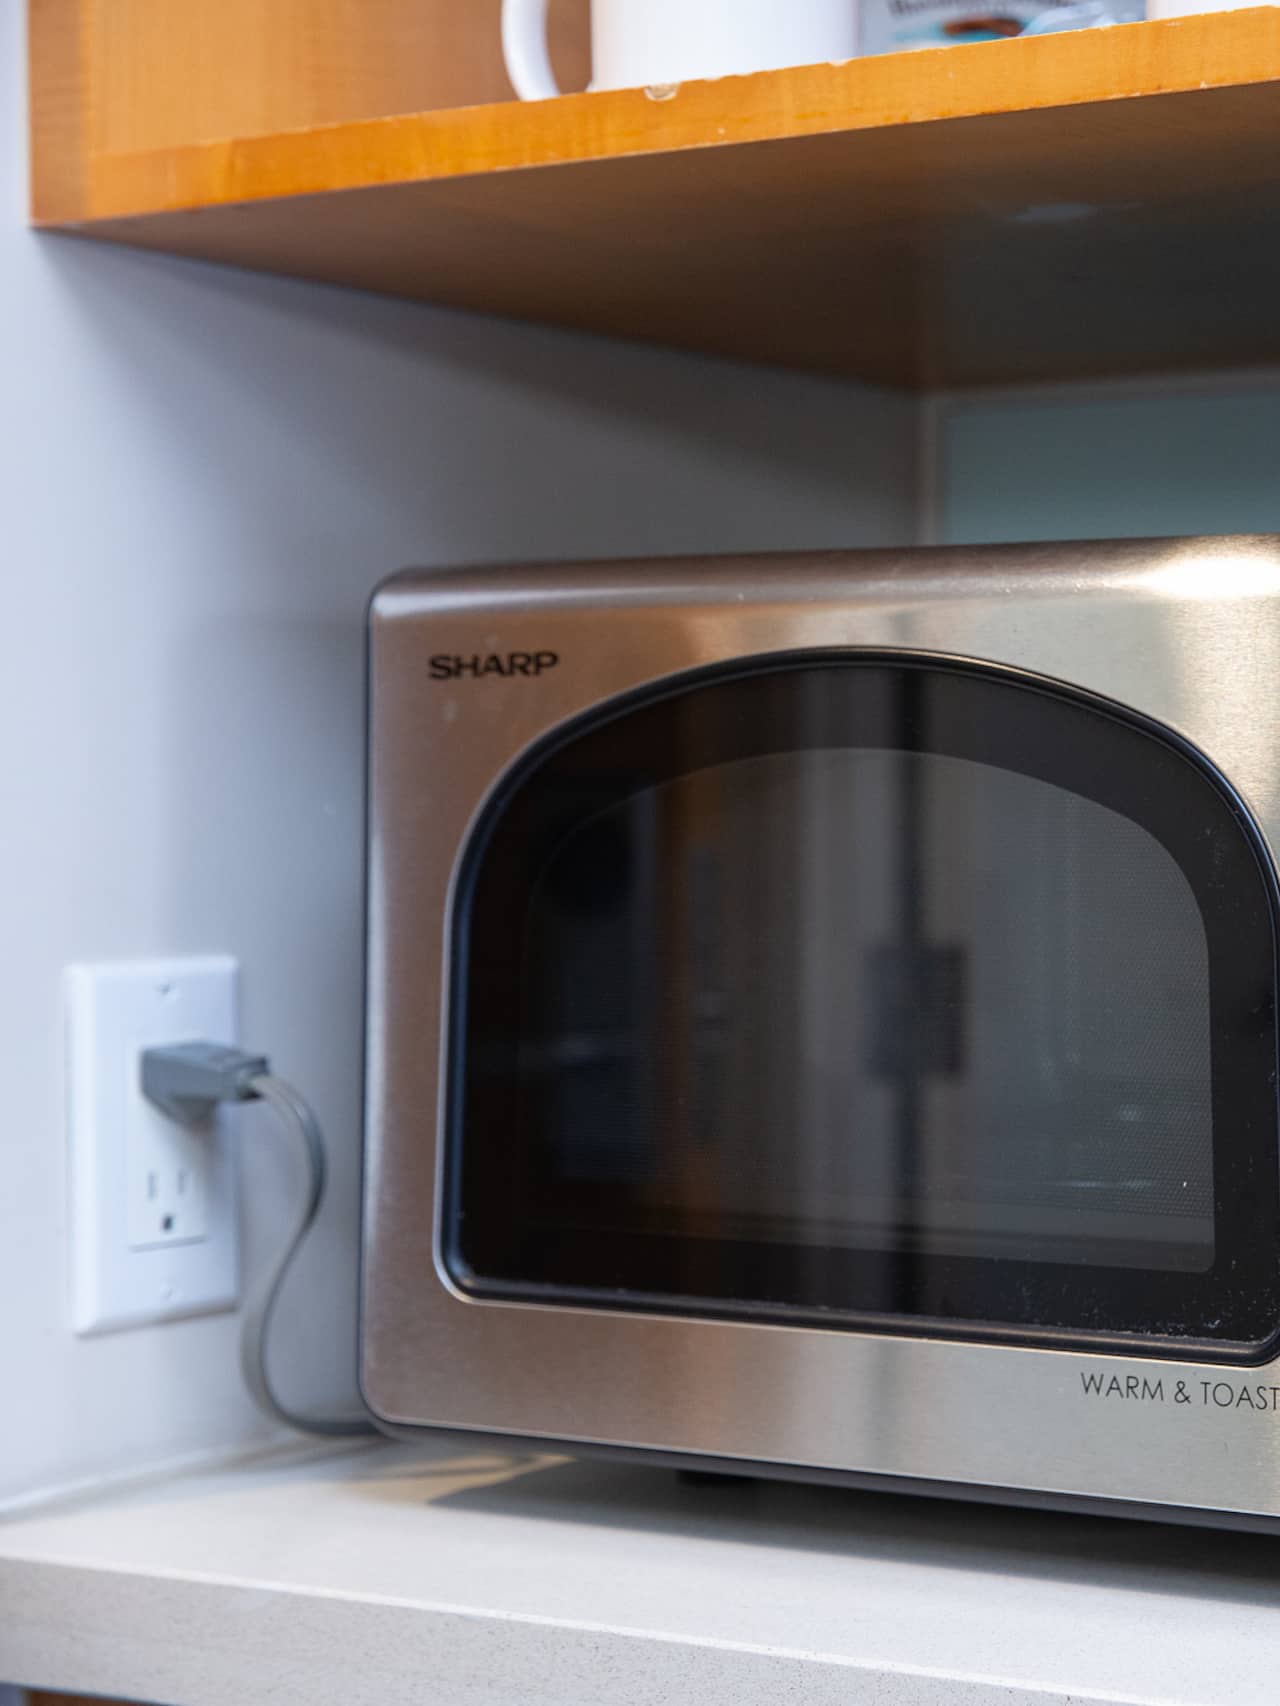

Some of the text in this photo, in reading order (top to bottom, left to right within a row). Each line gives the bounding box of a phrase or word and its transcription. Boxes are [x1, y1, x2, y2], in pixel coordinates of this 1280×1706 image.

[428, 650, 558, 680] SHARP
[1081, 1372, 1163, 1400] WARM
[1174, 1380, 1191, 1404] &
